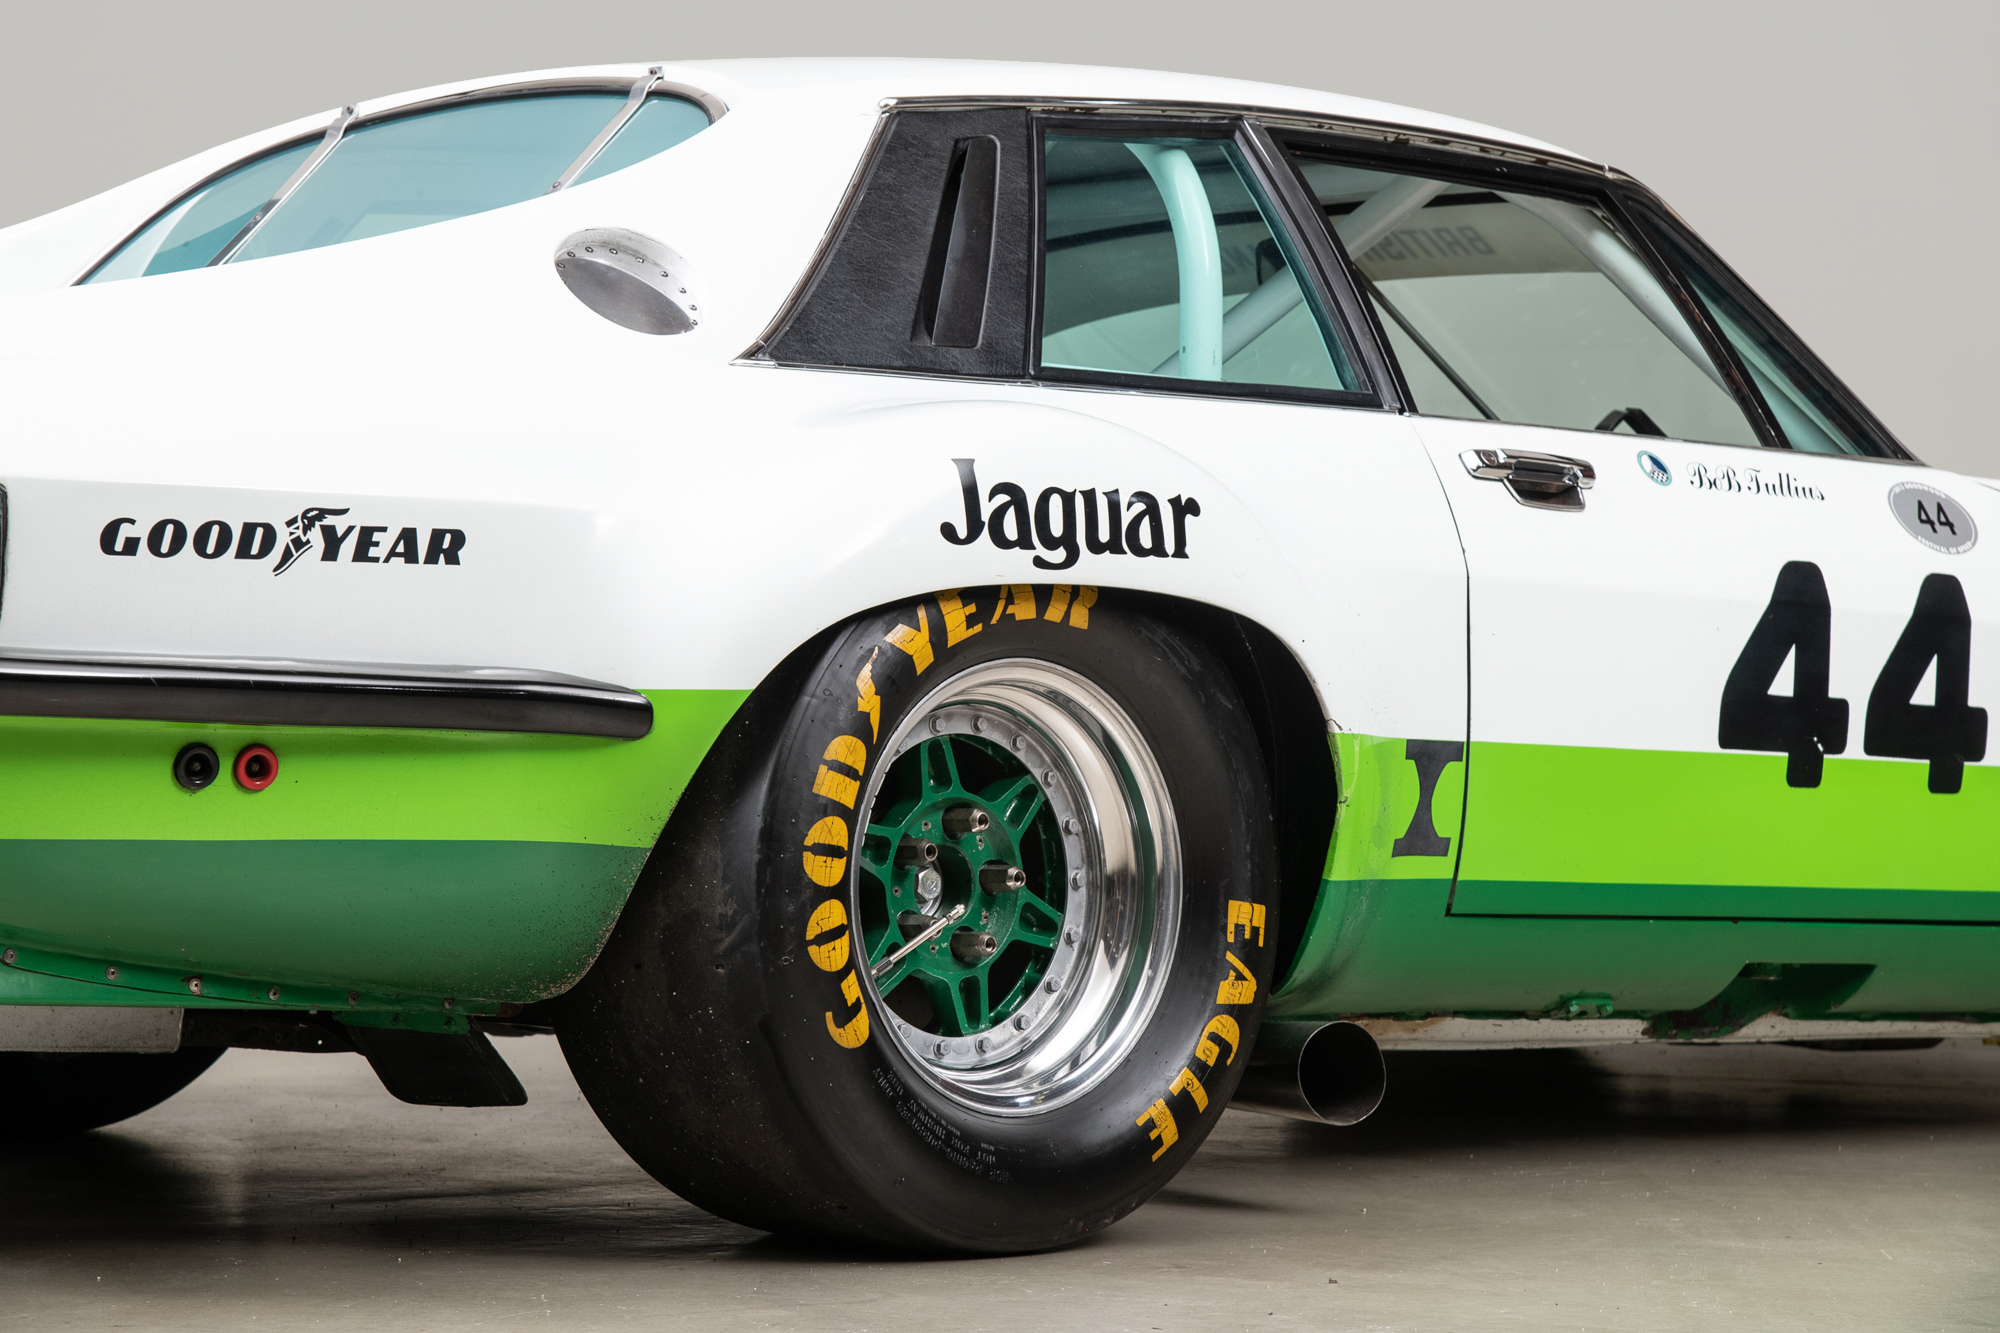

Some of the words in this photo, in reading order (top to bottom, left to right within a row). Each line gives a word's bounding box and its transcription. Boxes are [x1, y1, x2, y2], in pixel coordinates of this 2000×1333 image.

[1743, 467, 1825, 501] Tullius
[1904, 482, 1946, 499] GOODWOOD
[940, 458, 1201, 570] Jaguar
[1917, 499, 1957, 536] 44
[1917, 535, 1949, 554] FESTIVAL
[1949, 546, 1958, 554] OF
[1718, 560, 1988, 794] 44
[1135, 900, 1266, 1162] EAGLE
